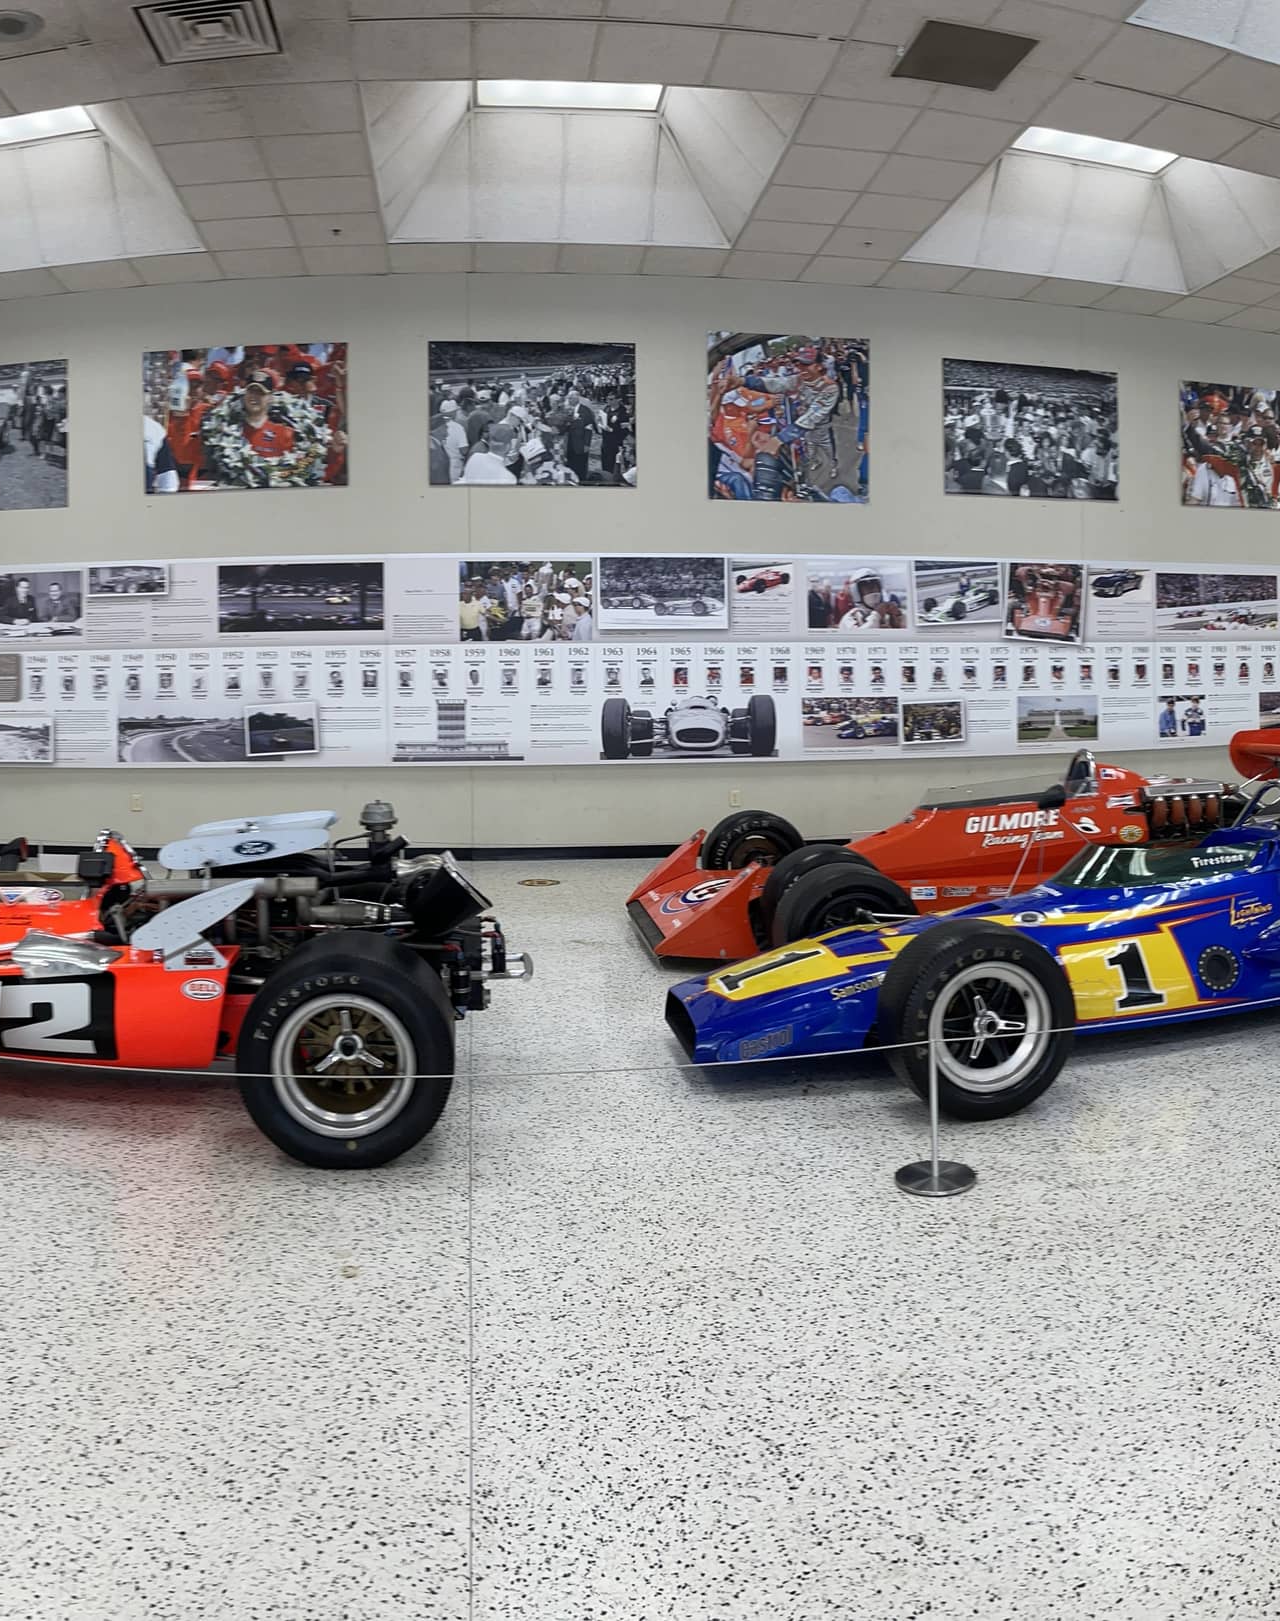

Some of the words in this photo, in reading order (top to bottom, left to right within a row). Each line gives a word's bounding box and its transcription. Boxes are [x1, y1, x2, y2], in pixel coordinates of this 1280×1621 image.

[464, 649, 485, 657] 1959
[498, 648, 520, 657] 1960
[534, 648, 554, 657] 1961
[568, 647, 590, 656] 1962
[602, 647, 624, 656] 1963
[636, 647, 657, 656] 1964
[670, 647, 691, 656] 1965
[703, 647, 725, 656] 1966
[964, 808, 1060, 833] GILMORE
[713, 819, 771, 866] OODYEAR
[982, 833, 1031, 848] Racing
[1190, 853, 1244, 869] Firestone
[1105, 941, 1168, 1011] 1
[189, 982, 218, 994] BELL
[0, 982, 98, 1054] 2
[739, 1024, 794, 1060] Castrol
